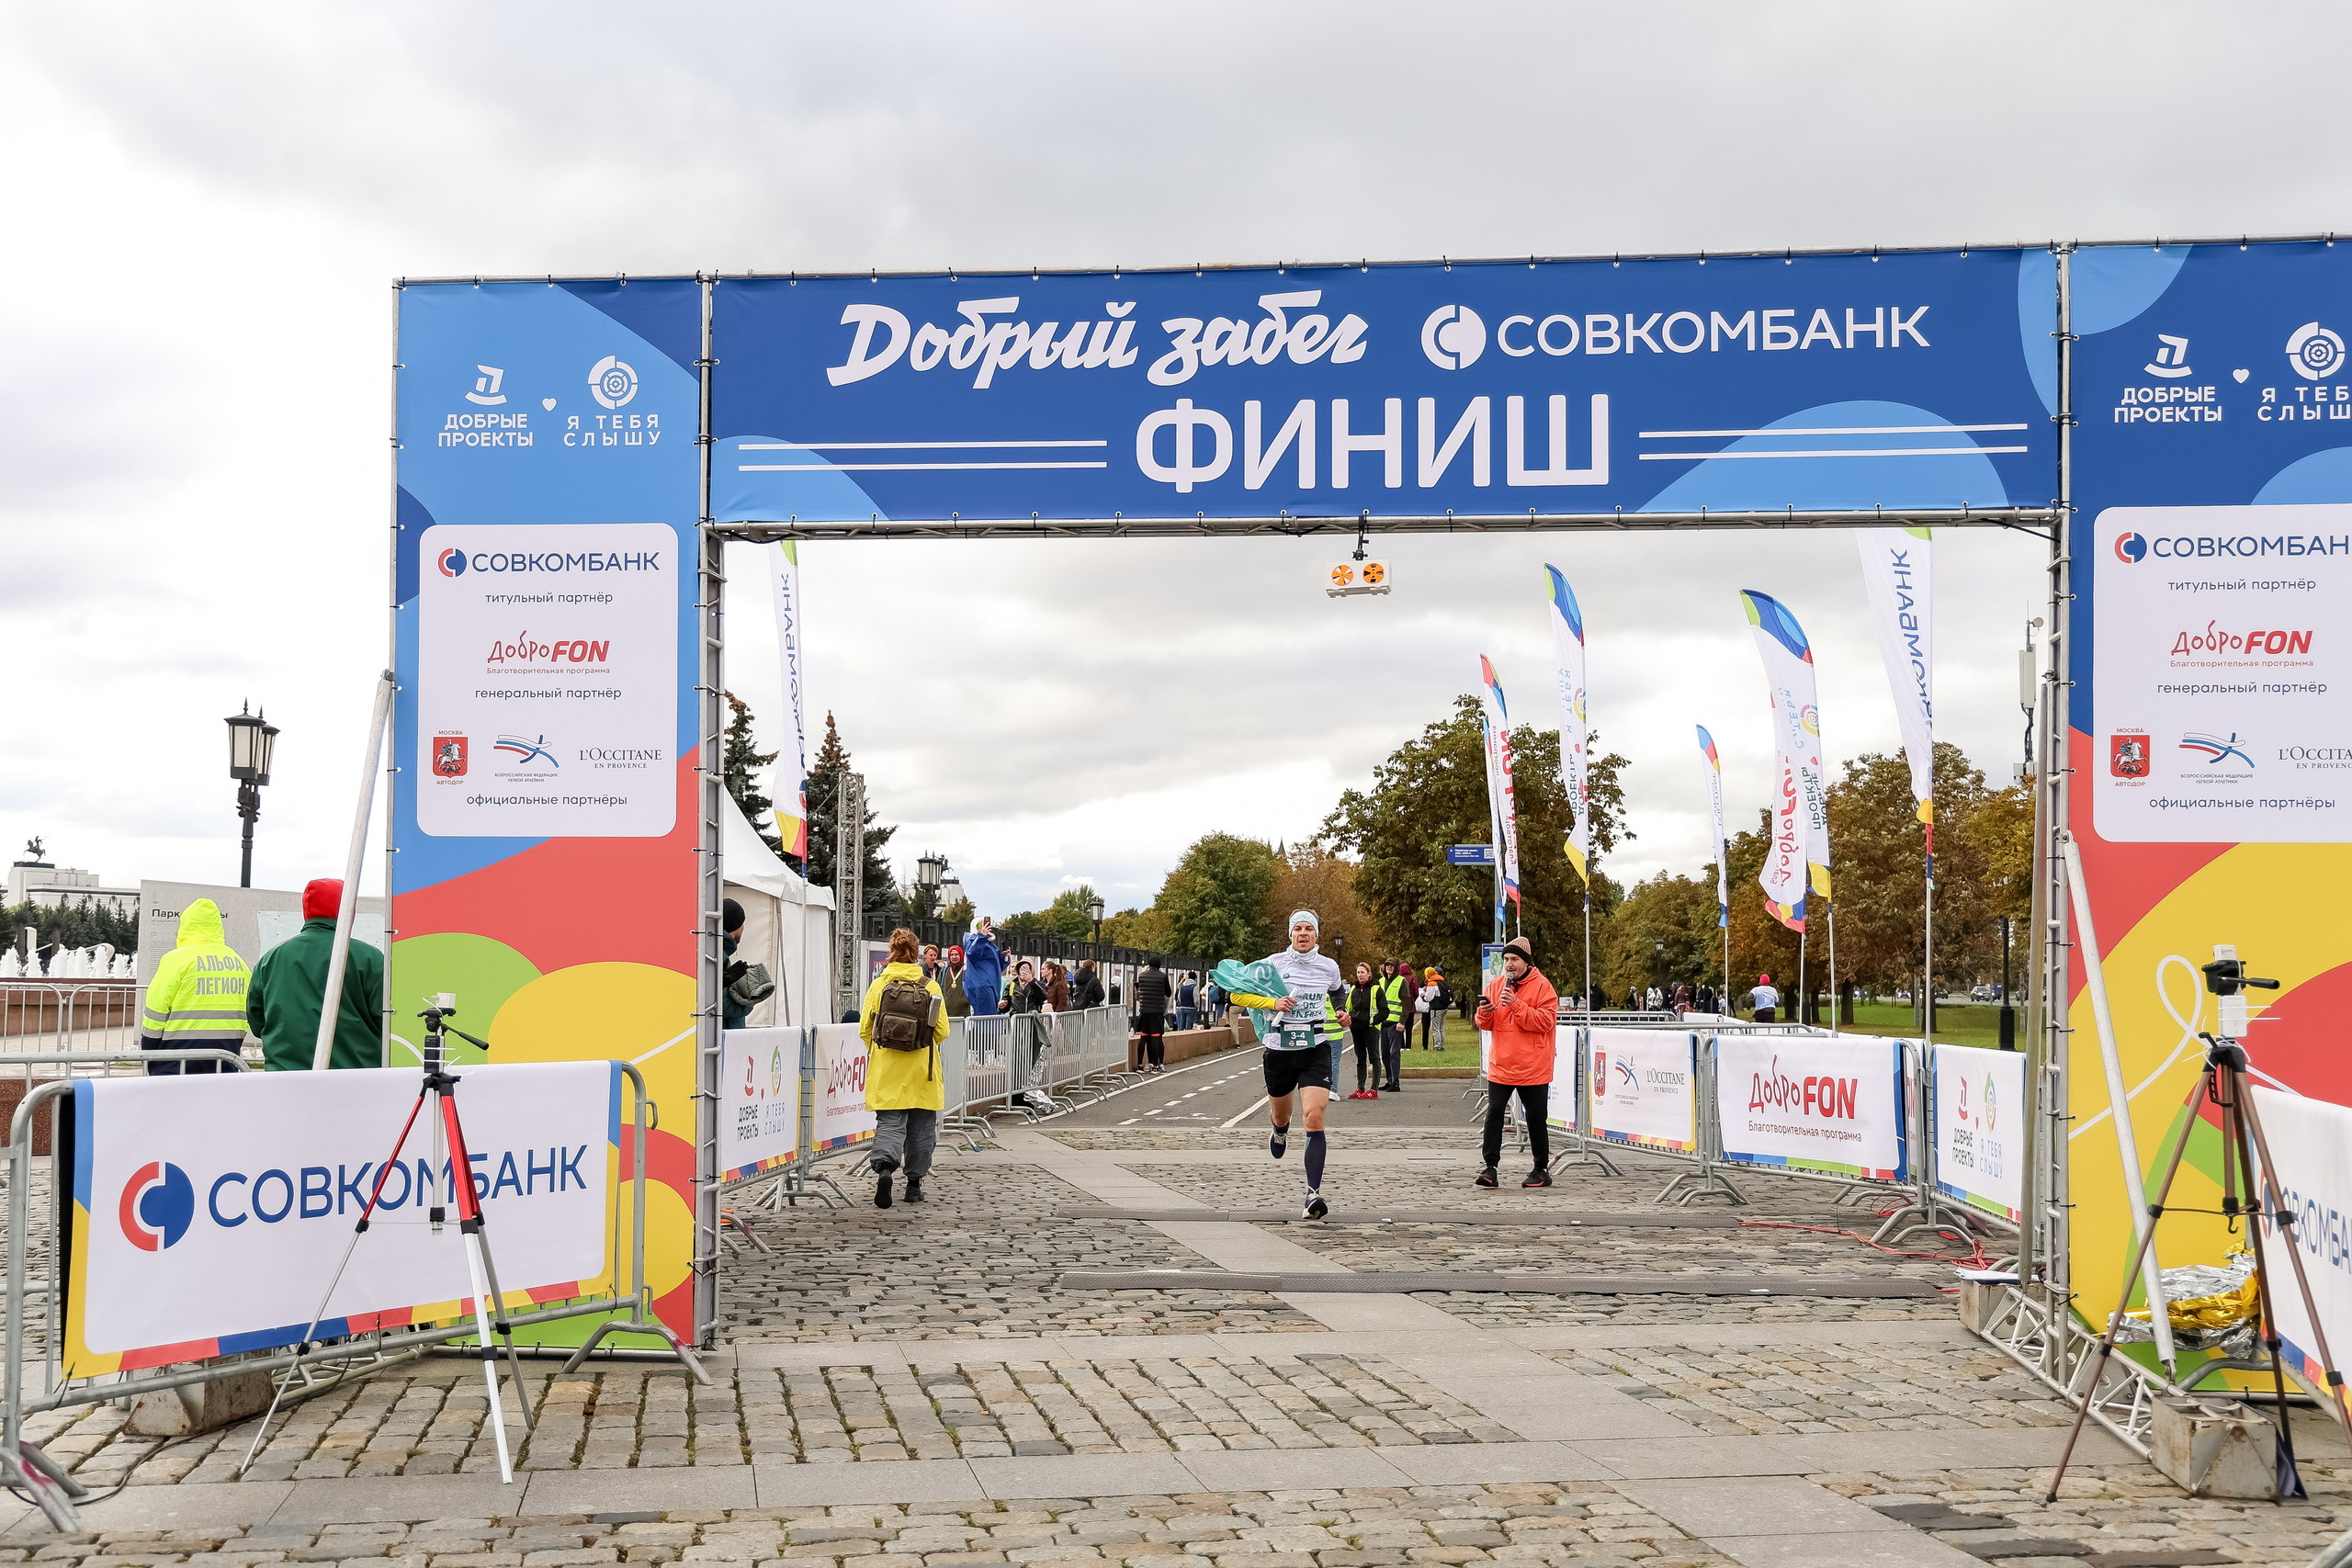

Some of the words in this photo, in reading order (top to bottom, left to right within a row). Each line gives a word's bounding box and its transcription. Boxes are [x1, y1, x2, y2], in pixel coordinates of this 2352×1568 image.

[1498, 306, 1929, 357] СОВКОМБАНК
[827, 296, 1138, 389] Добрый
[1147, 290, 1369, 386] забег
[2120, 386, 2216, 405] ДОБРЫЕ
[2261, 388, 2276, 402] Я
[445, 413, 528, 430] ДОБРЫЕ
[567, 415, 580, 430] Я
[595, 413, 660, 429] ТЕБЯ
[2114, 406, 2222, 423] ПРОЕКТЫ
[438, 432, 533, 447] ПРОЕКТЫ
[563, 431, 661, 446] СЛЫШУ
[1136, 393, 1609, 493] ФИНИШ
[472, 552, 660, 572] СОВКОМБАНК
[2168, 579, 2246, 592] титульный
[2252, 579, 2316, 592] партнёр
[485, 592, 553, 604] титульный
[558, 592, 613, 604] партнёр
[486, 667, 564, 675] Благотворительная
[2170, 660, 2259, 669] Благотворительная
[2261, 660, 2313, 669] программа
[475, 688, 562, 700] генеральный
[566, 688, 622, 700] партнёр
[2157, 682, 2256, 695] генеральный
[2262, 682, 2327, 695] партнёр
[580, 747, 662, 761] L'OCCITANE
[467, 794, 558, 807] официальные
[562, 794, 628, 807] партнёры
[2149, 796, 2254, 809] официальные
[2259, 796, 2335, 809] партнёры
[152, 908, 180, 919] Парк
[197, 955, 244, 972] АЛЬФА
[196, 976, 245, 996] ЛЕГИОН
[1748, 1120, 1819, 1137] Благотворительная
[1821, 1128, 1862, 1143] программа
